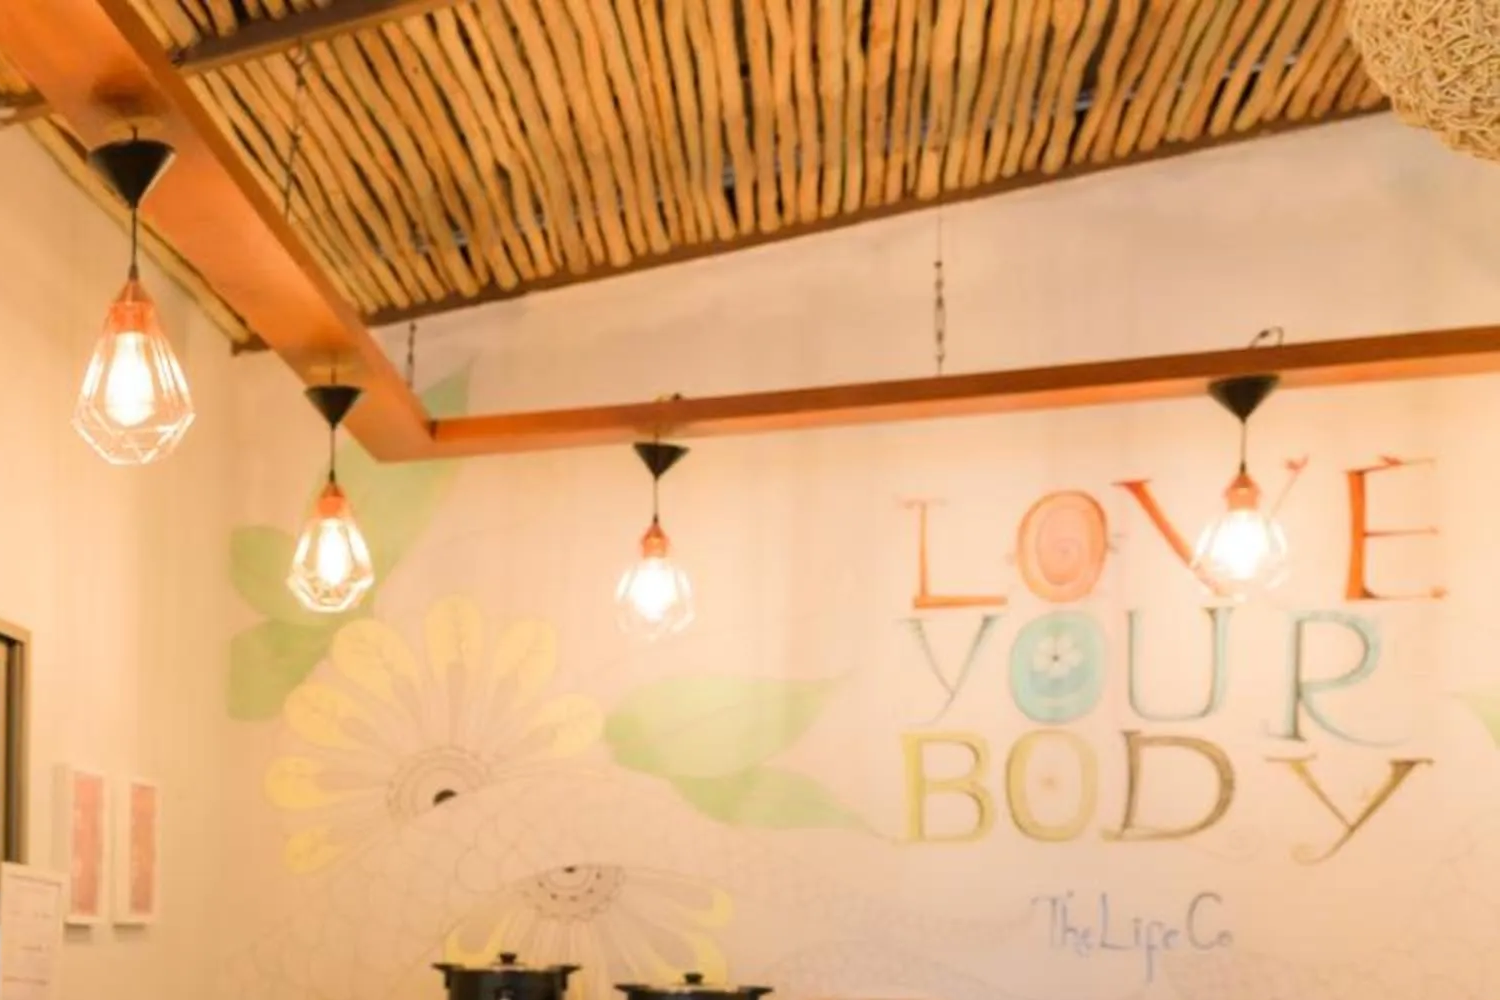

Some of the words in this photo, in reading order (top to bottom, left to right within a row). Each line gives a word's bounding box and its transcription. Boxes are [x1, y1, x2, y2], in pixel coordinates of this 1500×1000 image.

[900, 457, 1447, 608] LOVE
[899, 605, 1412, 748] YOUR
[900, 729, 1436, 865] BODY
